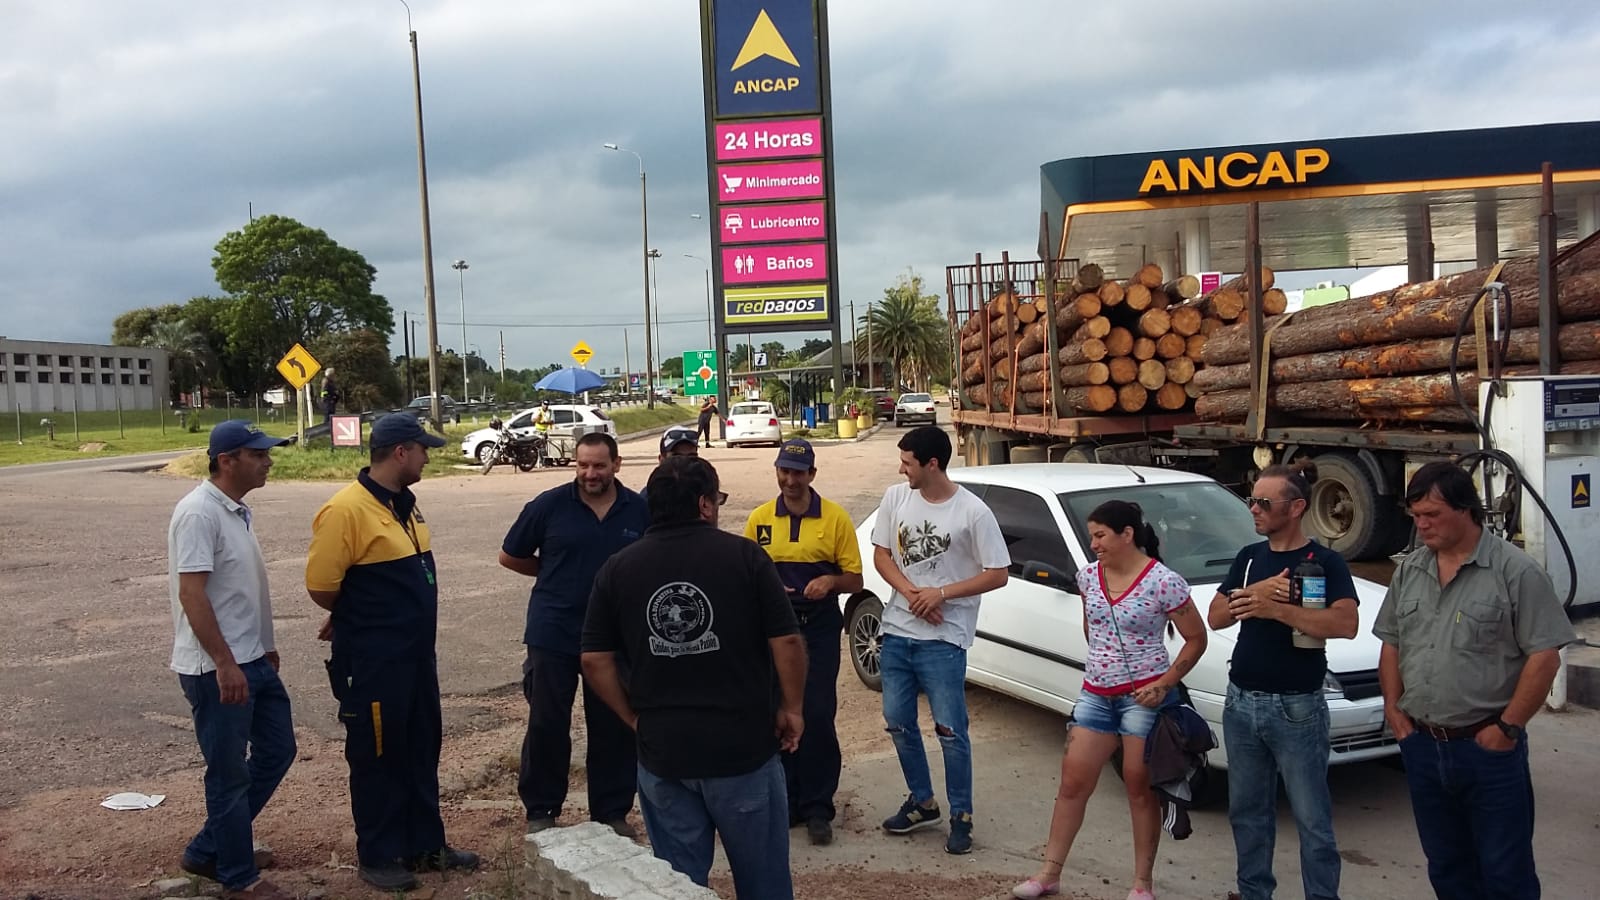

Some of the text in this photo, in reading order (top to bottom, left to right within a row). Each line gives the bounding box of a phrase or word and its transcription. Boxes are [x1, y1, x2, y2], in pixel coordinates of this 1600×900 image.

[733, 77, 800, 95] ANCAP
[724, 129, 814, 151] 24 Horas
[1138, 148, 1331, 193] ANCAP
[745, 173, 820, 188] Minimercado
[750, 215, 820, 229] Lubricentro
[766, 255, 814, 271] Baños
[736, 296, 815, 315] redpagos
